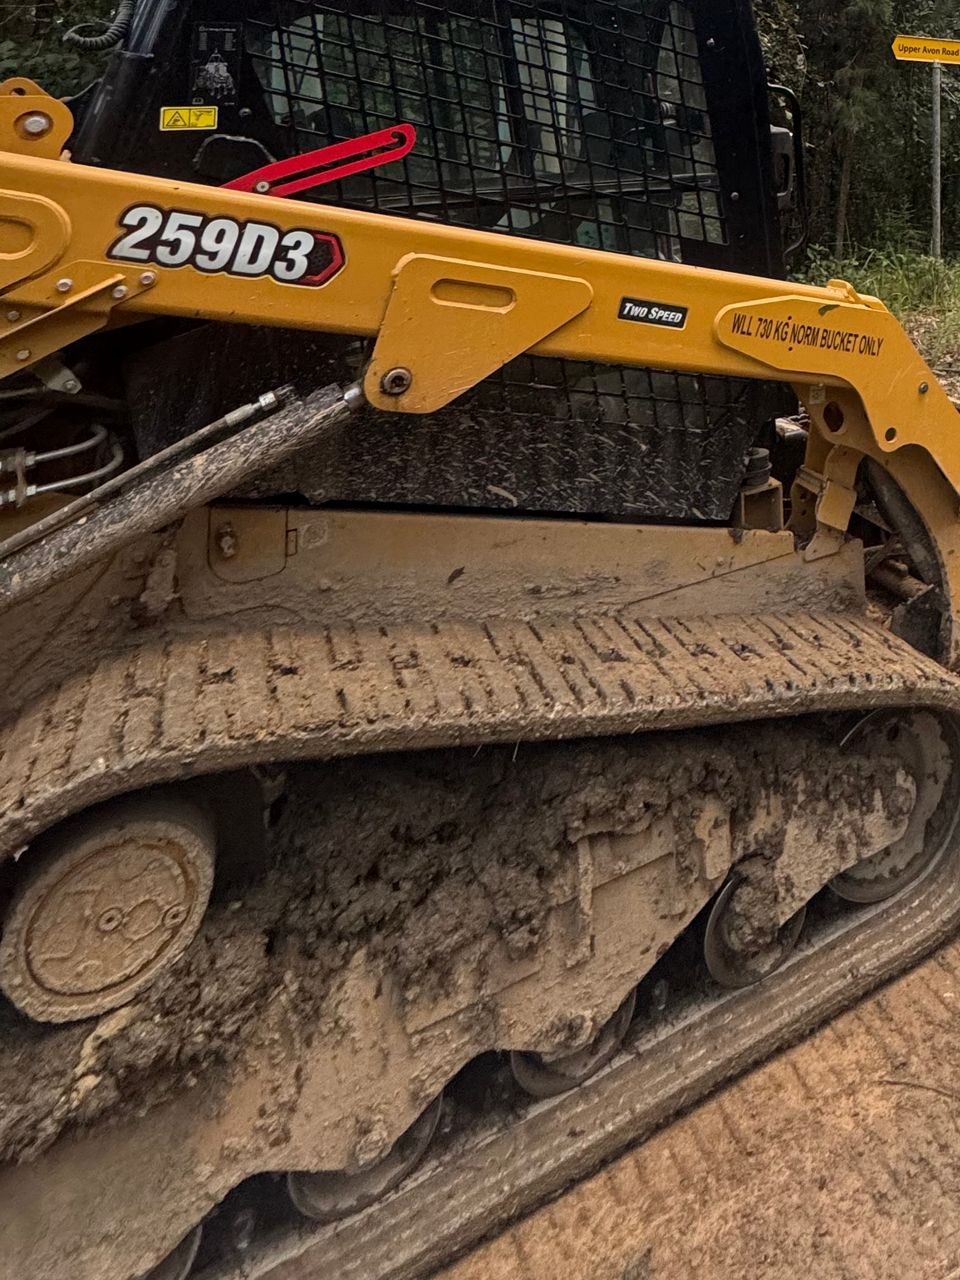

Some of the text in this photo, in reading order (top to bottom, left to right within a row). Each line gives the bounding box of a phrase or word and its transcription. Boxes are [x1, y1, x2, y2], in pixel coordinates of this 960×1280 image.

[898, 43, 960, 56] Upper Avon Road
[111, 206, 315, 280] 259D3
[732, 313, 884, 357] WLL 730 KG NORM BUCKET ONLY
